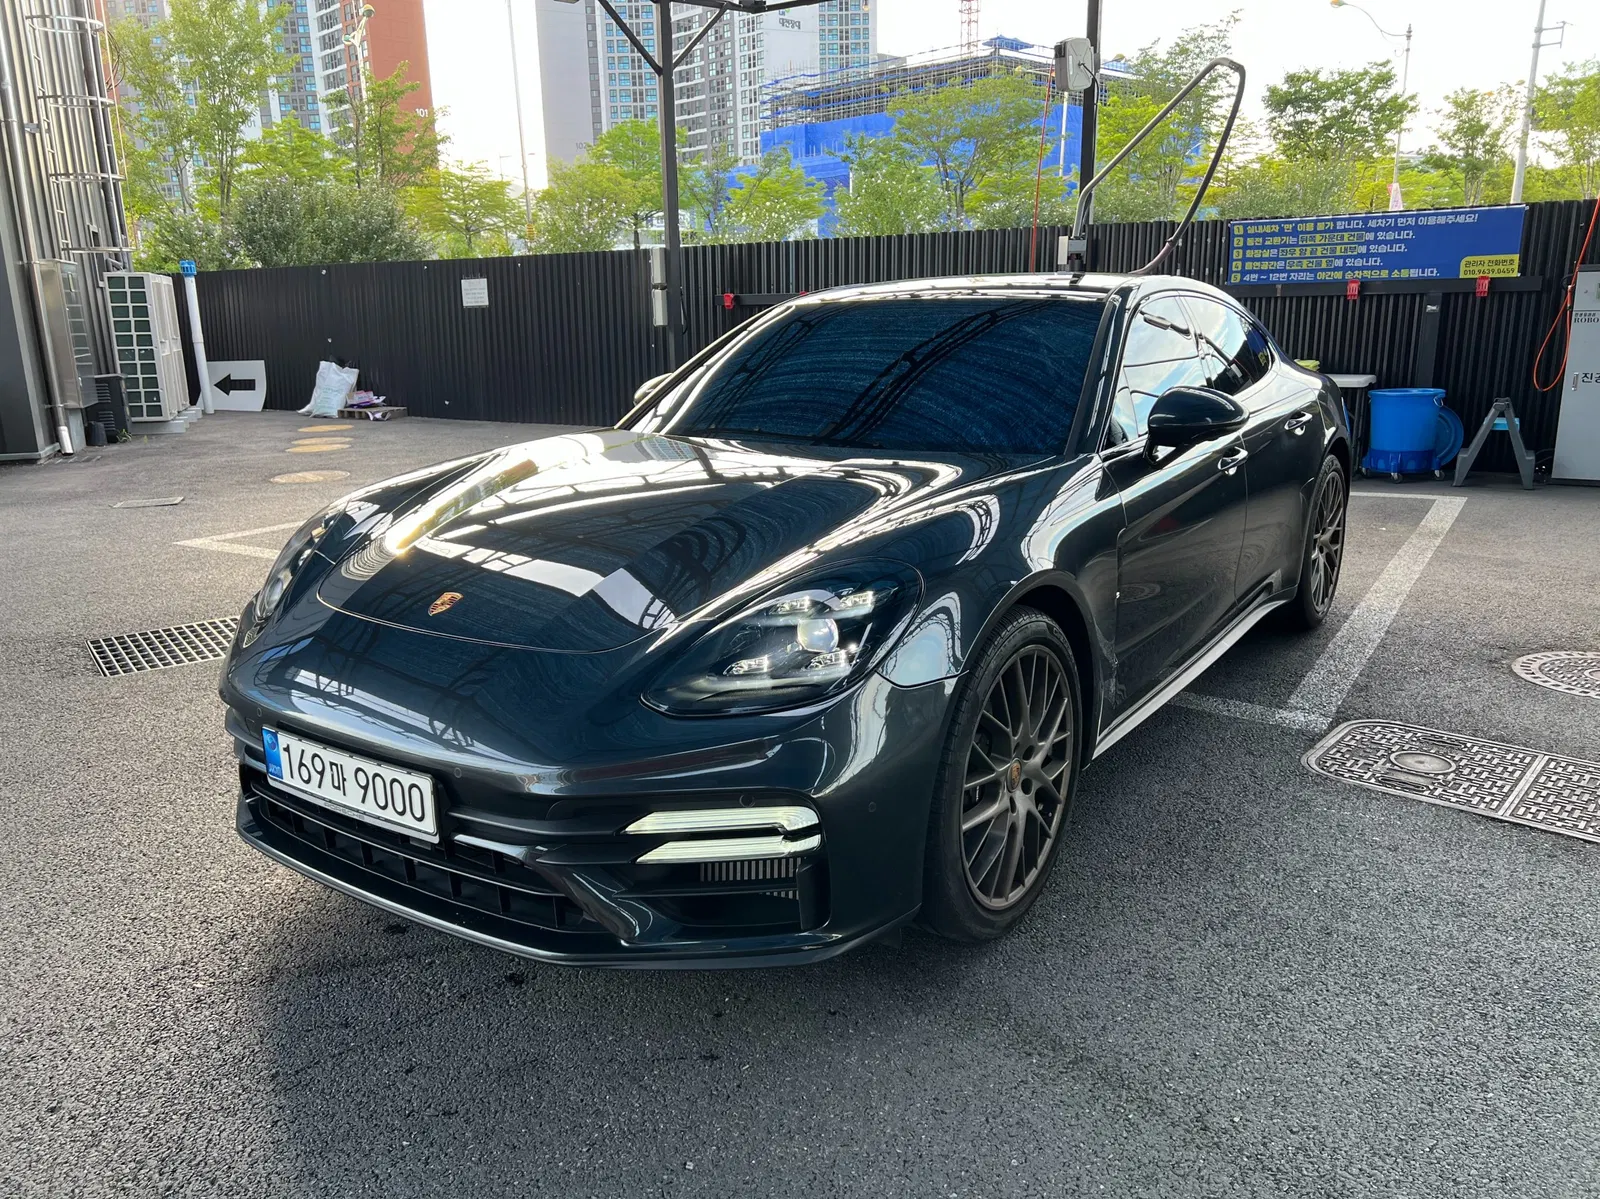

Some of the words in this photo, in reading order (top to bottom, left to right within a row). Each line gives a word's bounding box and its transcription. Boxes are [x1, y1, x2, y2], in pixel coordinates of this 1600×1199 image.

[415, 108, 428, 117] 101
[1247, 224, 1279, 233] 실내세차
[1297, 222, 1314, 231] 이용
[1317, 222, 1333, 231] 불가
[1336, 220, 1365, 230] 합니다.
[1367, 218, 1395, 228] 세차기
[1397, 217, 1416, 226] 먼저
[1418, 213, 1479, 225] 이용해주세요!
[1247, 237, 1262, 246] 동전
[1264, 235, 1298, 245] 교환기는
[1299, 235, 1316, 244] 뒤쪽
[1319, 233, 1344, 243] 가운데
[1377, 230, 1416, 240] 있습니다.
[1246, 248, 1278, 258] 화장실은
[1280, 247, 1297, 257] 좌우
[1299, 247, 1308, 256] 양
[1310, 247, 1318, 256] 끝
[1320, 246, 1337, 255] 건물
[1369, 243, 1408, 253] 있습니다.
[1245, 260, 1285, 270] 흡연공간은
[1287, 260, 1304, 269] 우측
[1306, 259, 1322, 268] 건물
[1345, 257, 1383, 267] 있습니다.
[1464, 259, 1485, 267] 관리자
[1487, 258, 1515, 267] 전화번호
[1243, 272, 1259, 281] 4번
[1269, 272, 1288, 281] 12번
[1289, 271, 1315, 281] 자리는
[1317, 270, 1343, 280] 야간에
[1345, 269, 1389, 279] 순차적으로
[1463, 267, 1515, 276] 010.9639.0459
[283, 743, 347, 796] 169마
[354, 766, 425, 822] 9000
